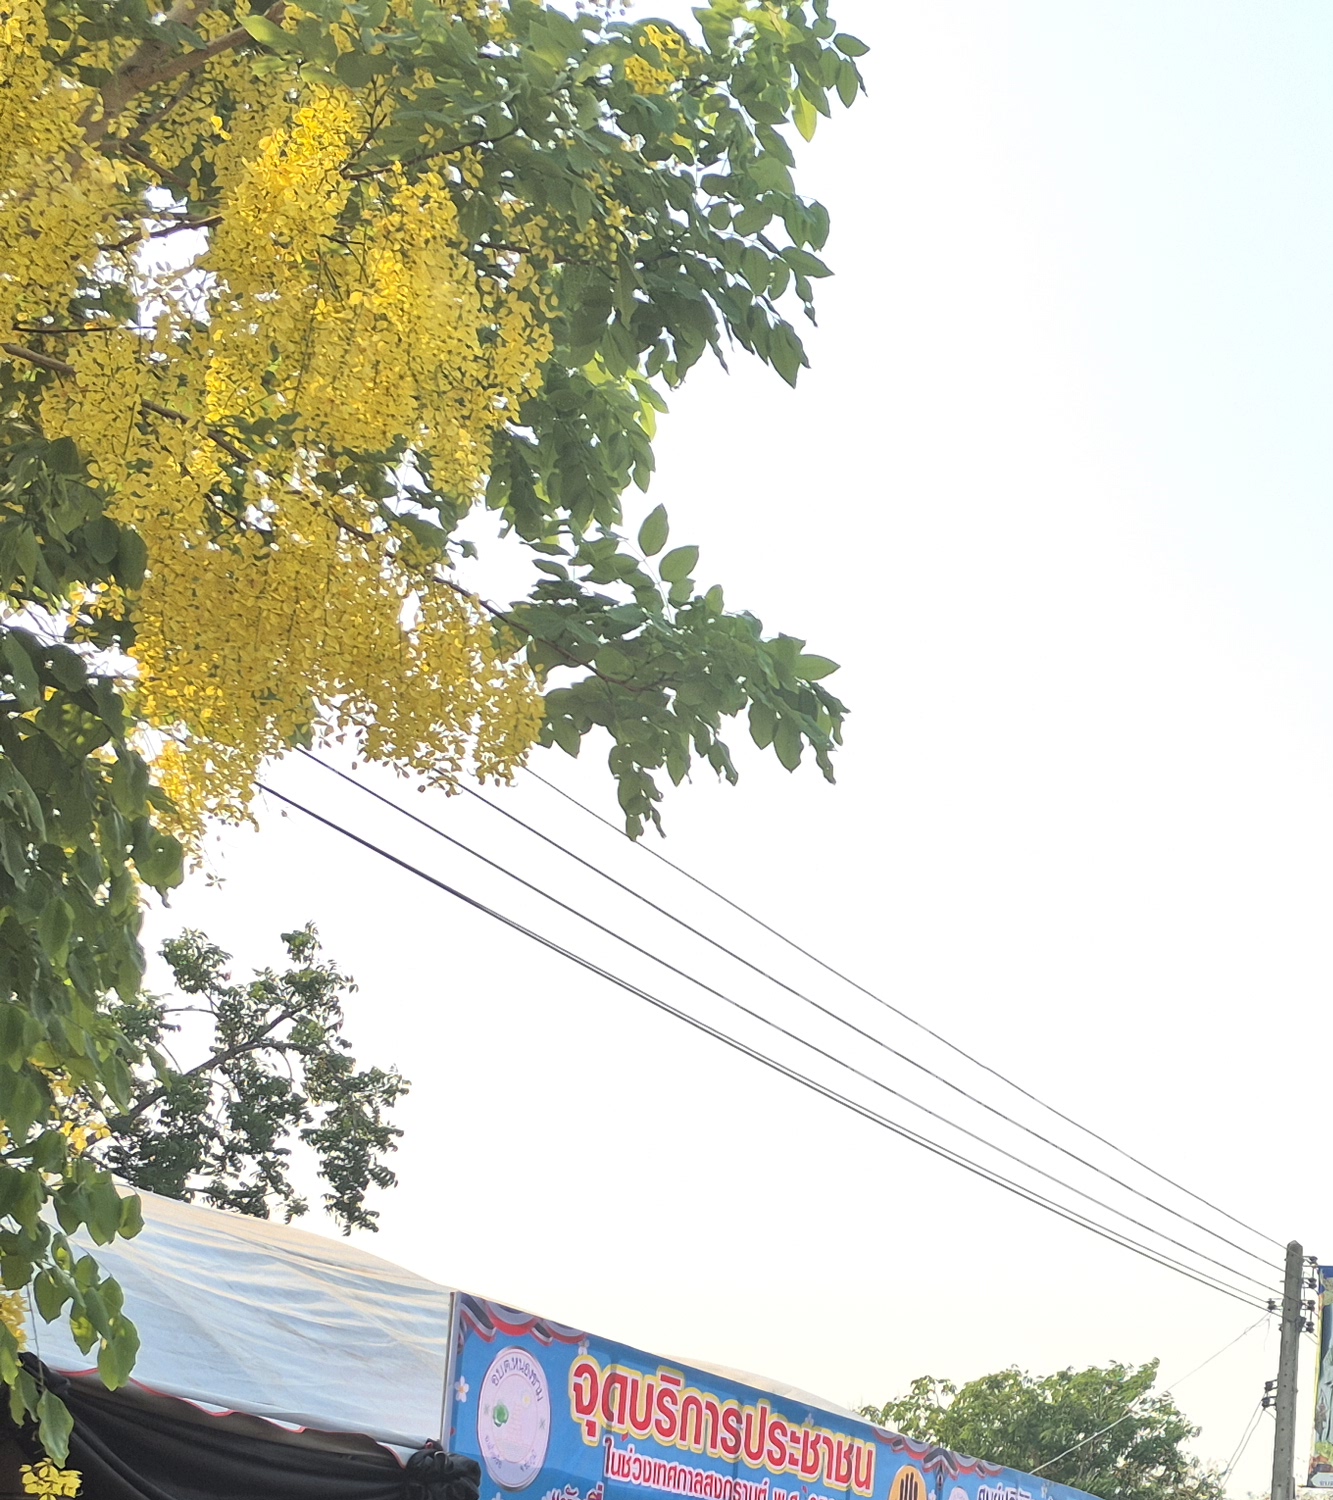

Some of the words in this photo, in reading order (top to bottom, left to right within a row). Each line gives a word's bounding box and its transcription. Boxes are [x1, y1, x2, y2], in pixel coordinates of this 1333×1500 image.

[572, 1361, 874, 1491] จุดบริการประชาชน
